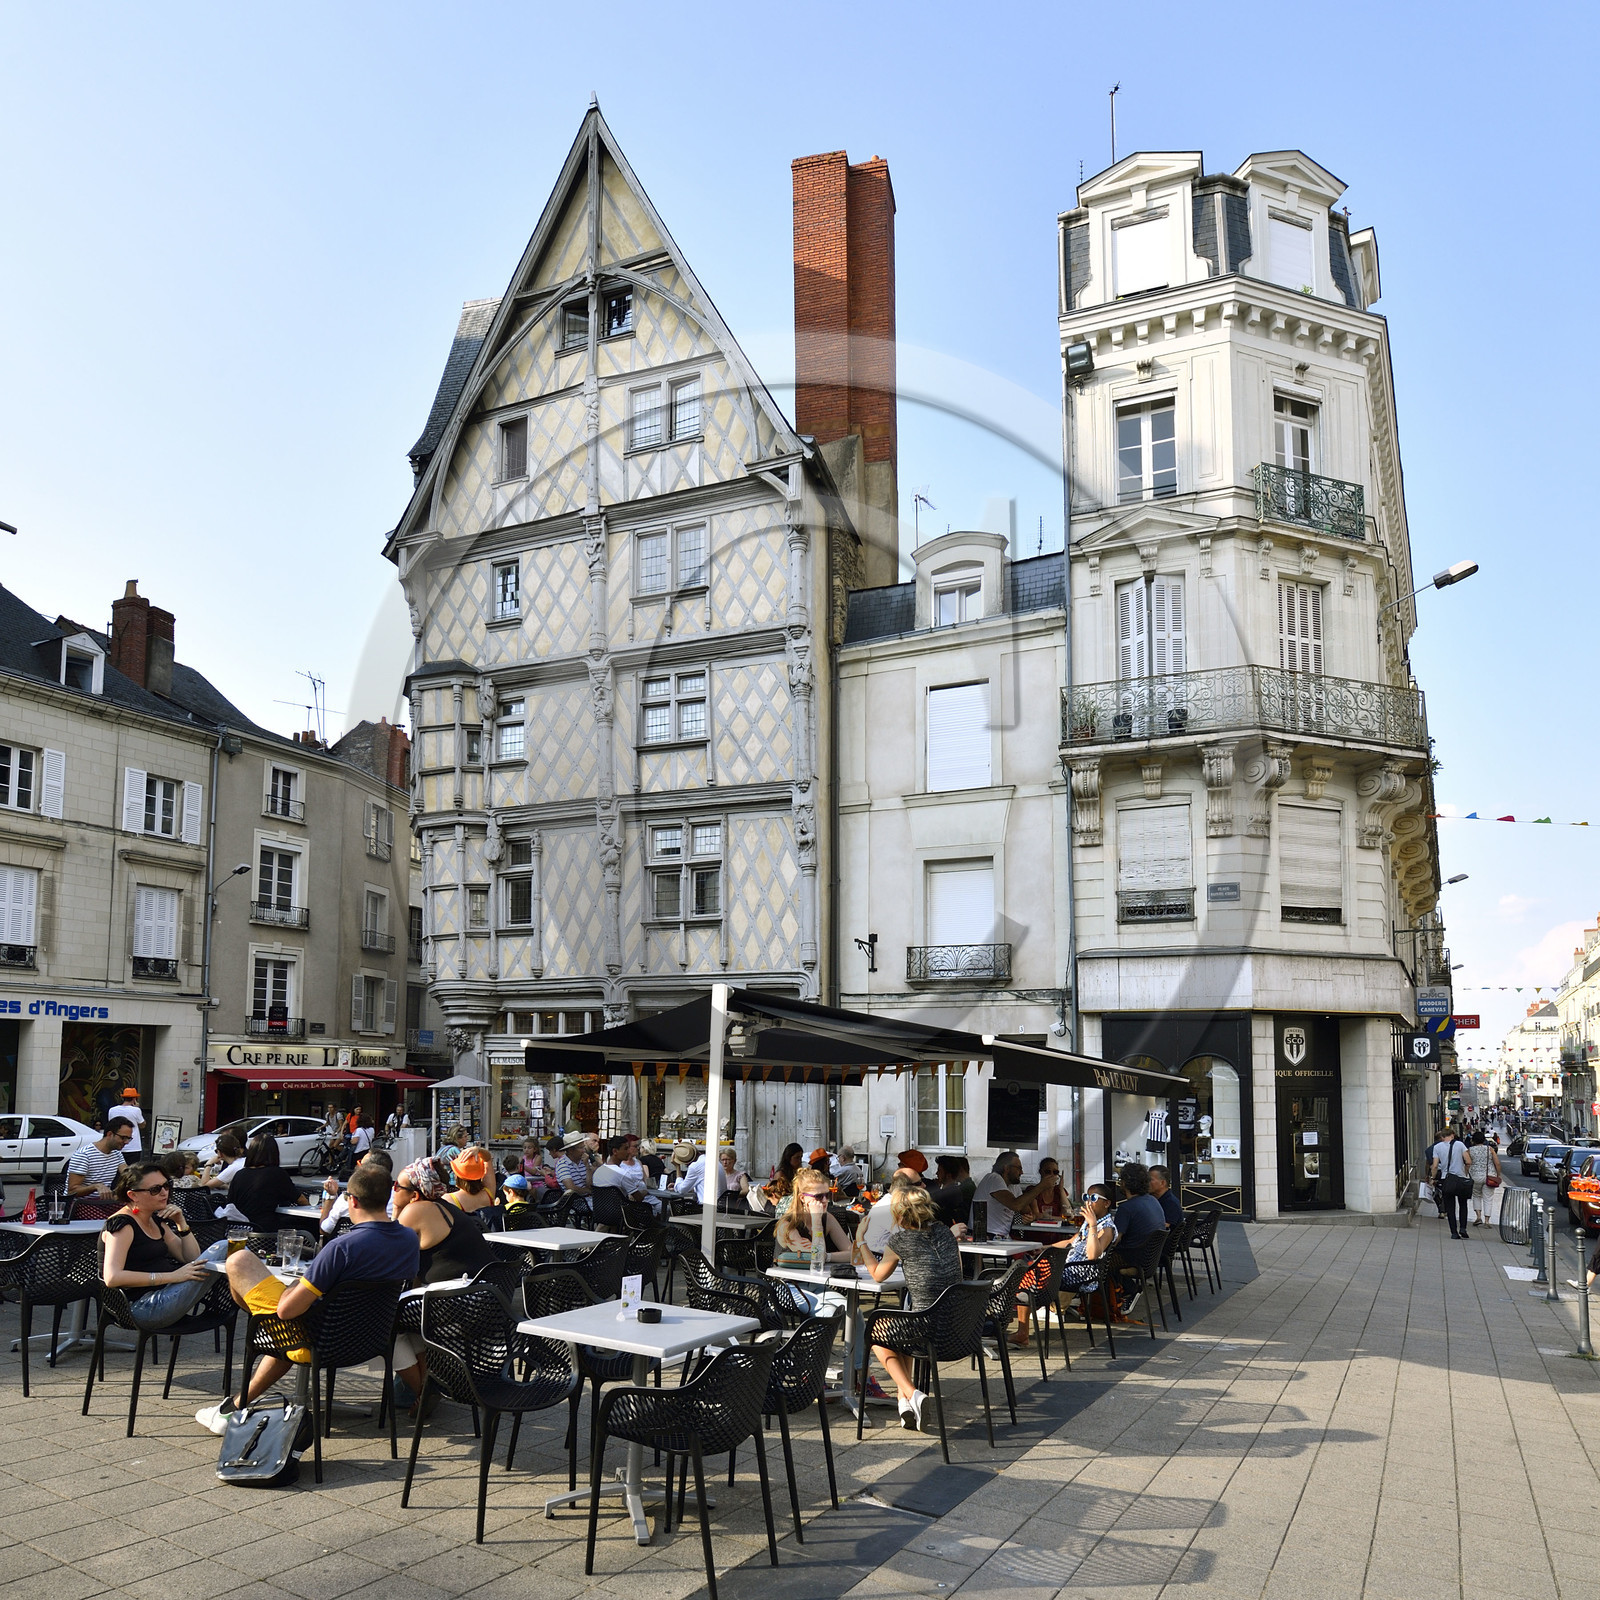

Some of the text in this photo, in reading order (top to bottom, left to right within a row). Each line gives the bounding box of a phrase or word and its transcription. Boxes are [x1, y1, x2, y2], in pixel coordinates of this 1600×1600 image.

[29, 1000, 109, 1020] d'Angers
[1286, 1037, 1303, 1045] SCO
[1109, 1071, 1120, 1088] LE
[1120, 1073, 1138, 1091] KENT
